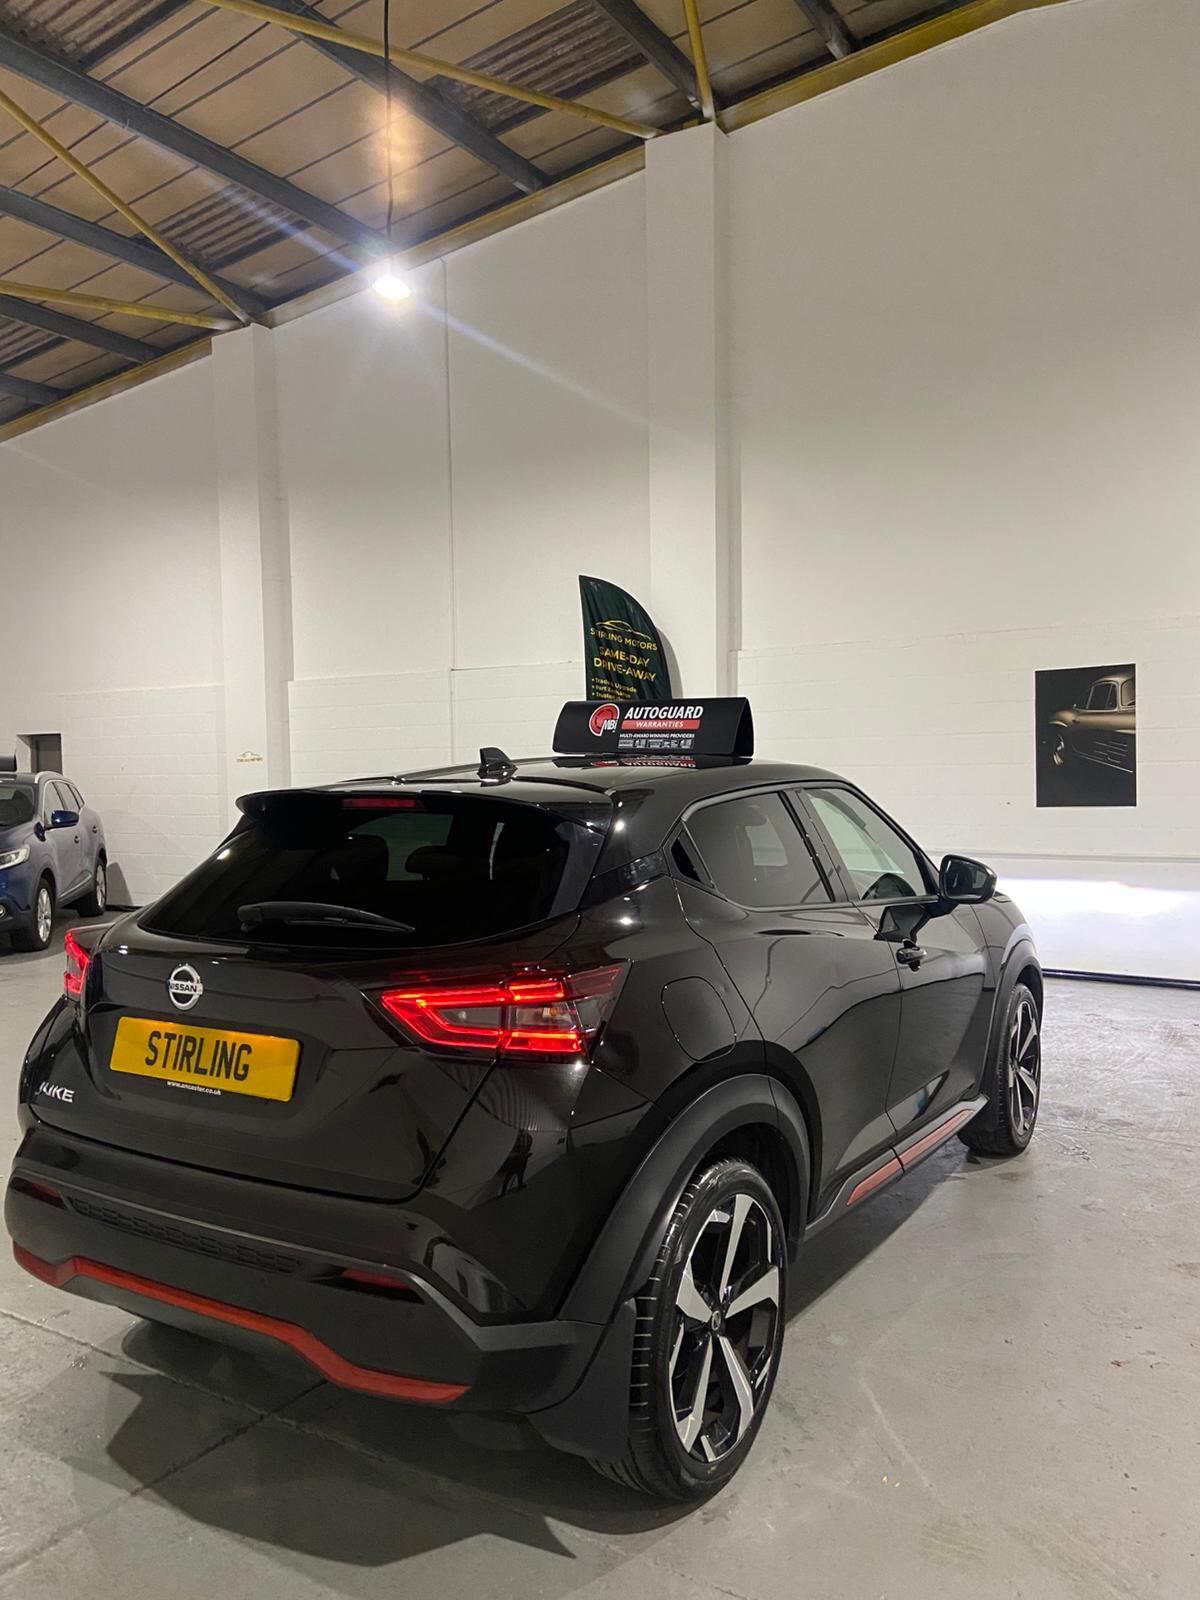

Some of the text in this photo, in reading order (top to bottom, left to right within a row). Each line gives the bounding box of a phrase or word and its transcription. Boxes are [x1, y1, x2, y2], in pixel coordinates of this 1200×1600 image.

[593, 657, 657, 682] DRIVE-AWAY
[624, 706, 704, 720] AUTOGUARD
[636, 721, 684, 729] WARRANTIES
[169, 982, 198, 993] NISSAN
[145, 1030, 252, 1082] STIRLING
[35, 1081, 75, 1103] JUKE
